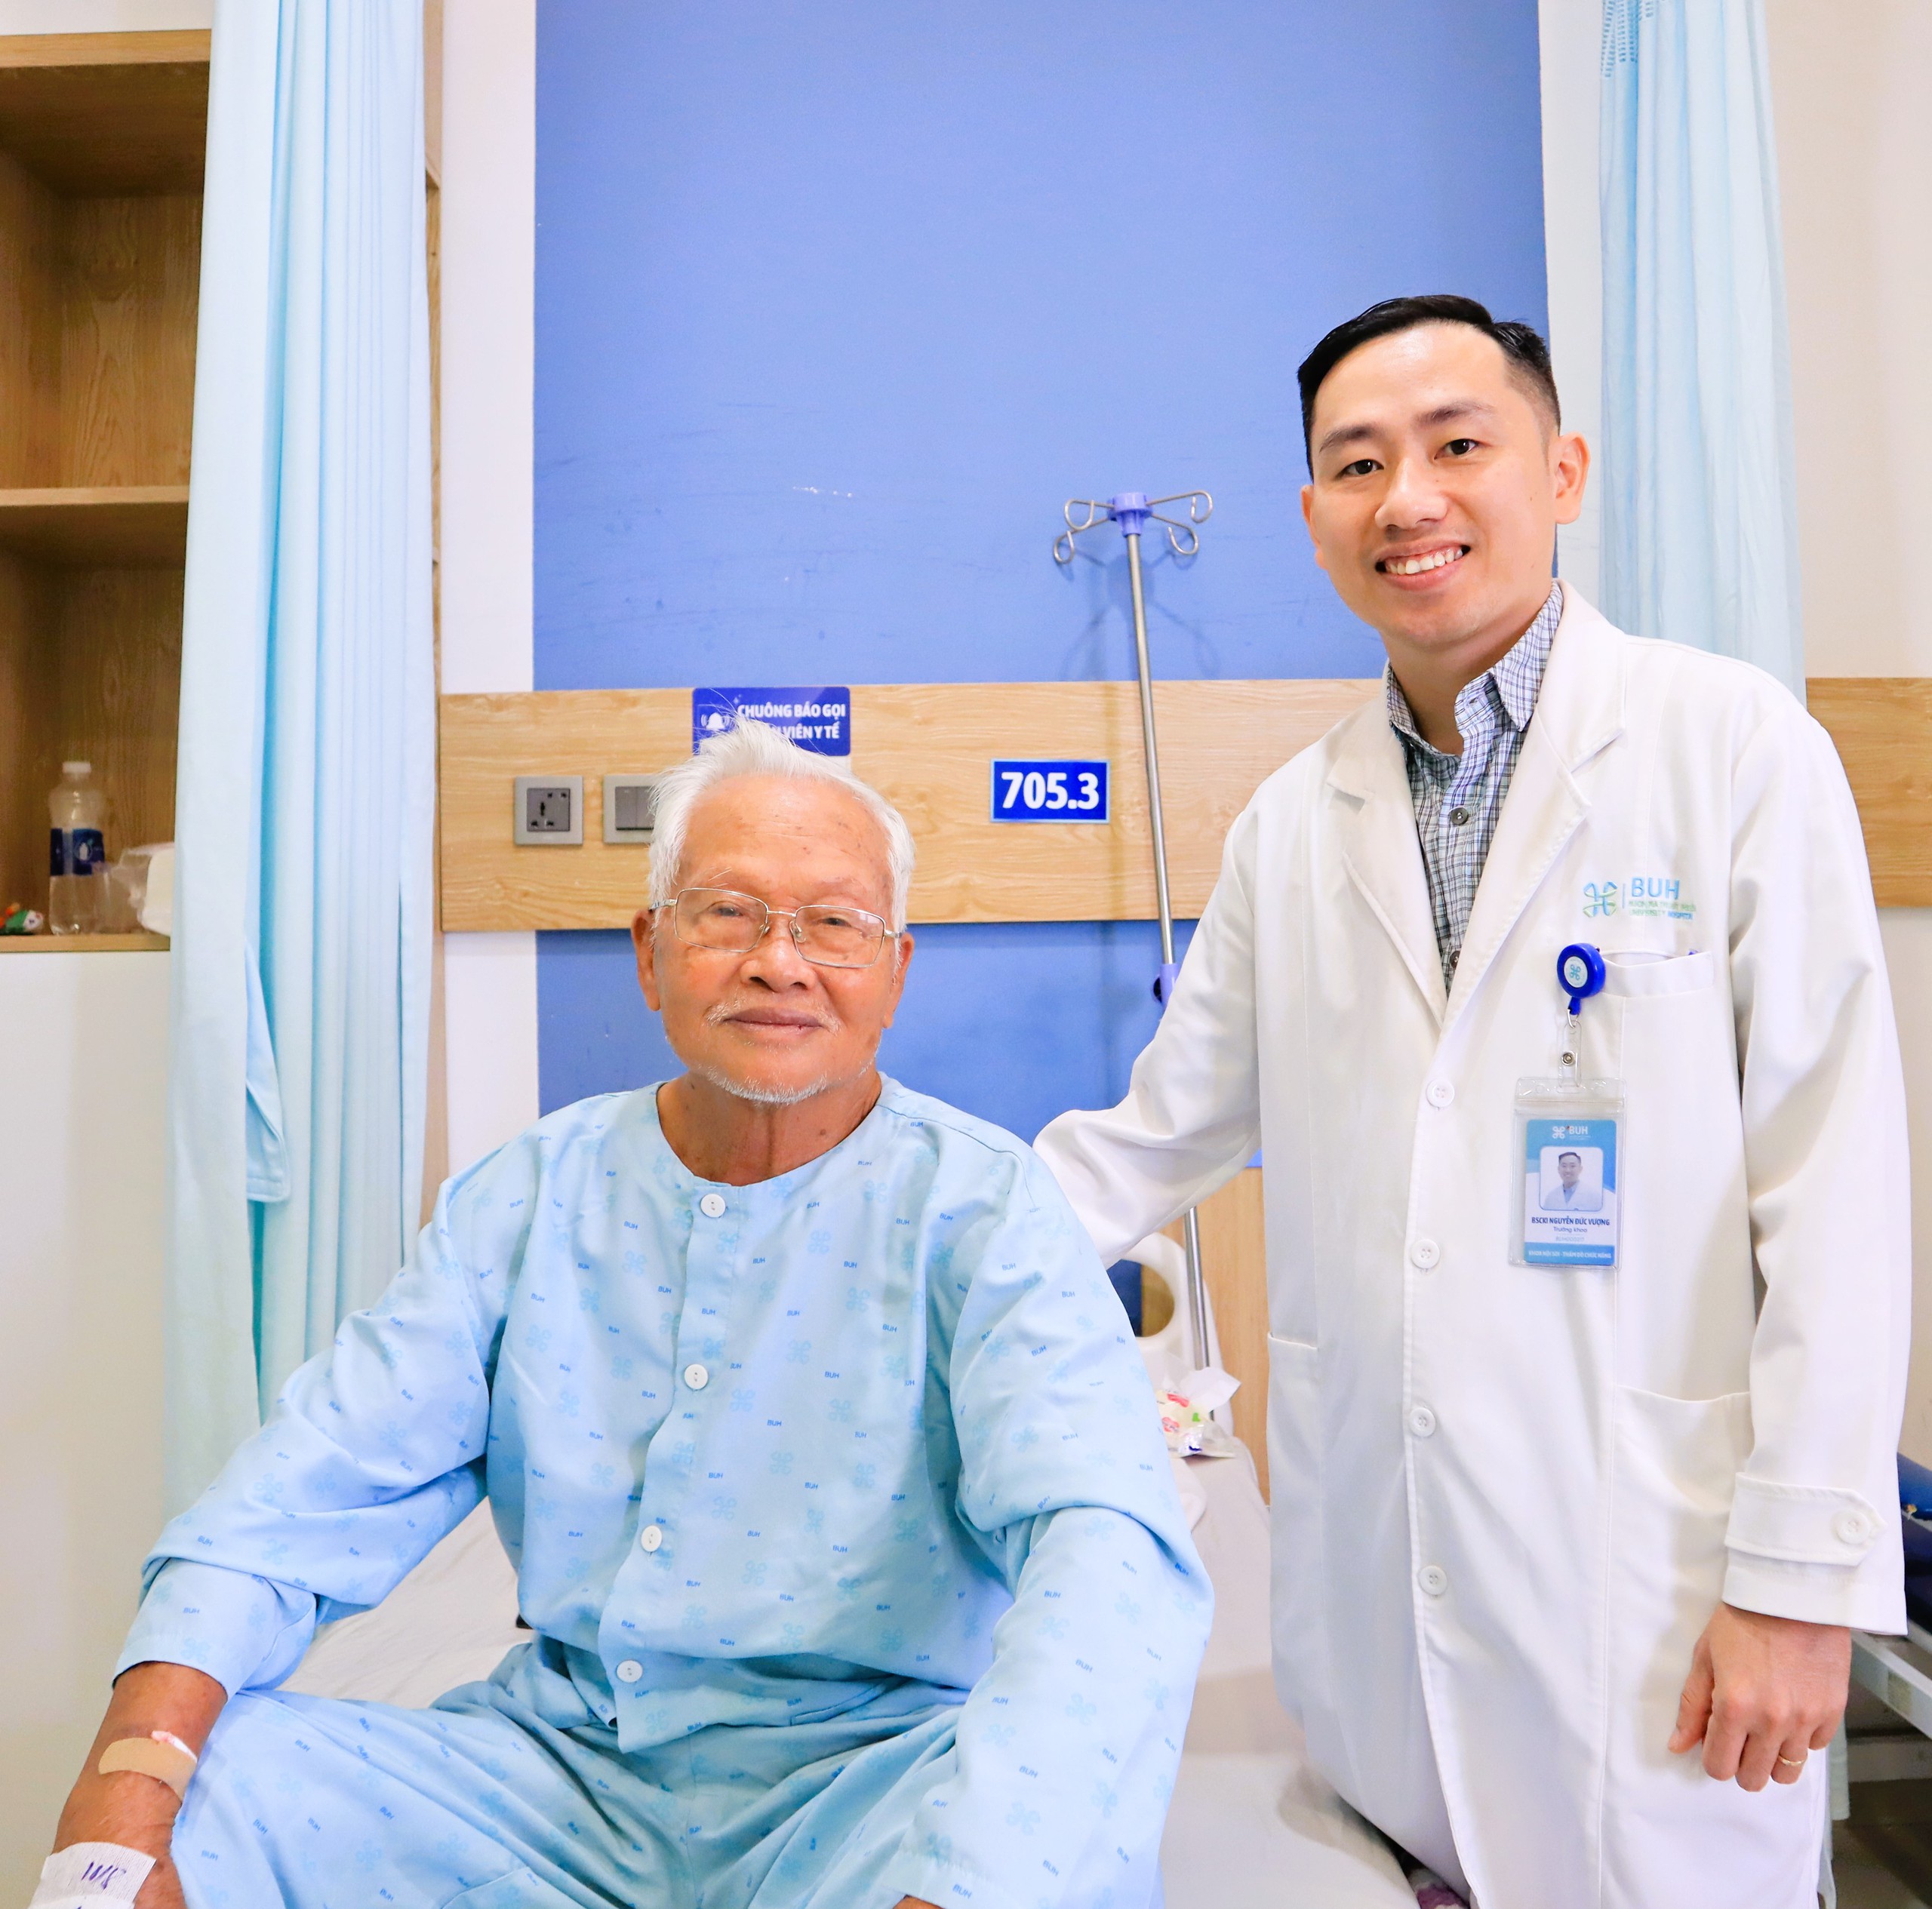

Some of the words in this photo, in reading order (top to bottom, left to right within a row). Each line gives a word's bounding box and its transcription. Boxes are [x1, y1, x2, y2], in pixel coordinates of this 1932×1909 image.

[737, 702, 792, 718] CHUÔNG
[794, 701, 821, 718] BÁO
[823, 704, 846, 720] GỌI
[783, 723, 812, 739] VIÊN
[813, 726, 823, 739] Y
[823, 721, 840, 739] TẾ
[1001, 771, 1100, 810] 705.3
[1631, 877, 1680, 900] BUH
[1569, 1126, 1589, 1136] BUH
[939, 1213, 954, 1222] BUH
[624, 1220, 638, 1229] BUH
[658, 1285, 672, 1293] BUH
[531, 1293, 546, 1303] BUH
[883, 1323, 897, 1333] BUH
[1032, 1345, 1048, 1357] BUH
[642, 1390, 656, 1400] BUH
[589, 1431, 604, 1441] BUH
[804, 1481, 819, 1489] BUH
[197, 1536, 213, 1547] BUH
[833, 1545, 848, 1553] BUH
[687, 1579, 702, 1588] BUH
[779, 1594, 795, 1602] BUH
[621, 1619, 636, 1630] BUH
[719, 1638, 735, 1646] BUH
[1075, 1658, 1094, 1673] BUH
[1019, 1766, 1038, 1778] BUH
